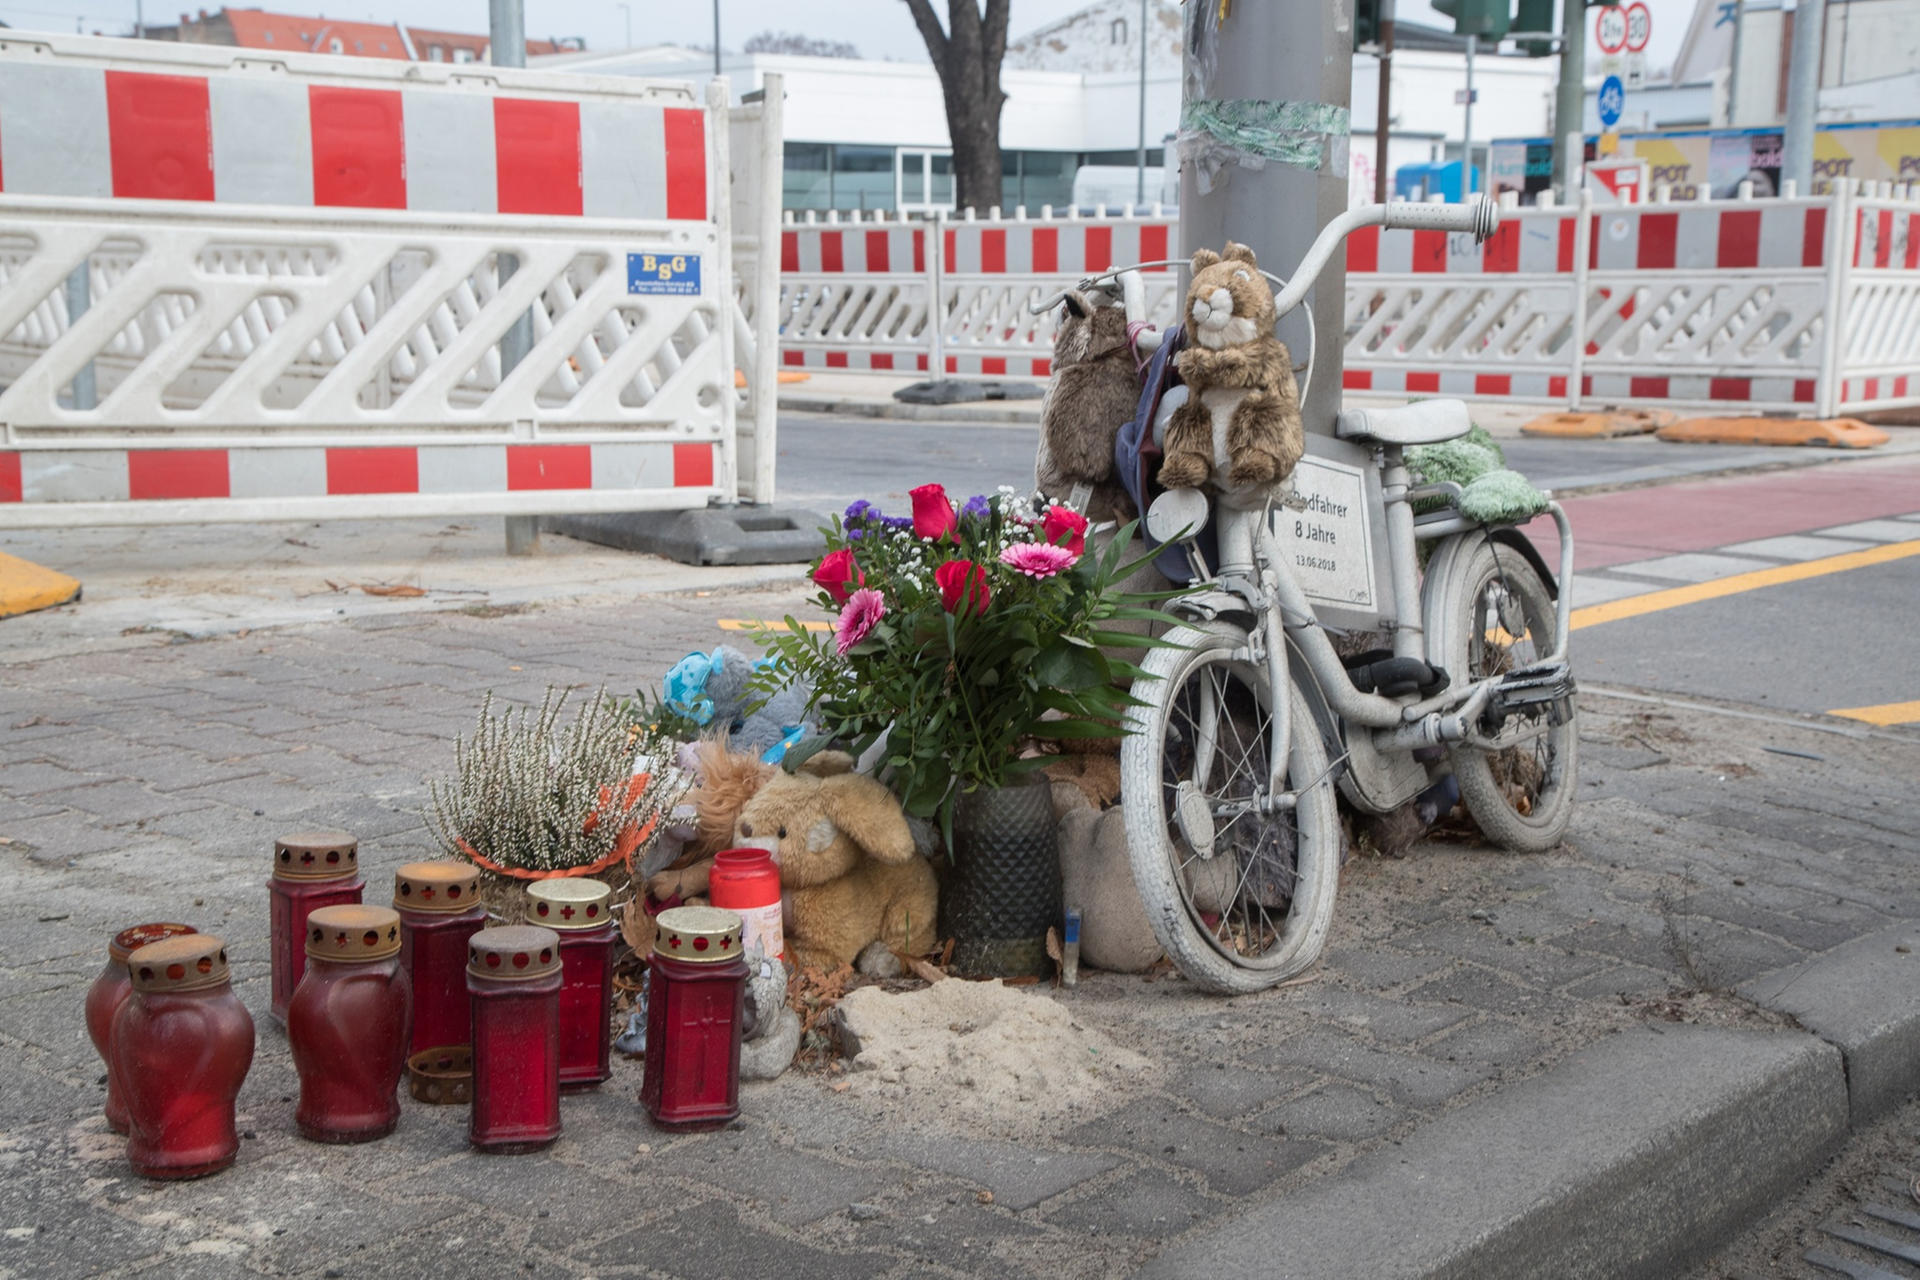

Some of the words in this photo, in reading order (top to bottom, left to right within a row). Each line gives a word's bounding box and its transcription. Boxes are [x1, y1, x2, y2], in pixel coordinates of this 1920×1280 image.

[1653, 163, 1691, 183] POT
[642, 255, 687, 280] BSG
[1295, 520, 1303, 538] 8
[1306, 523, 1336, 545] Jahre
[1296, 554, 1337, 572] 13.06.2018
